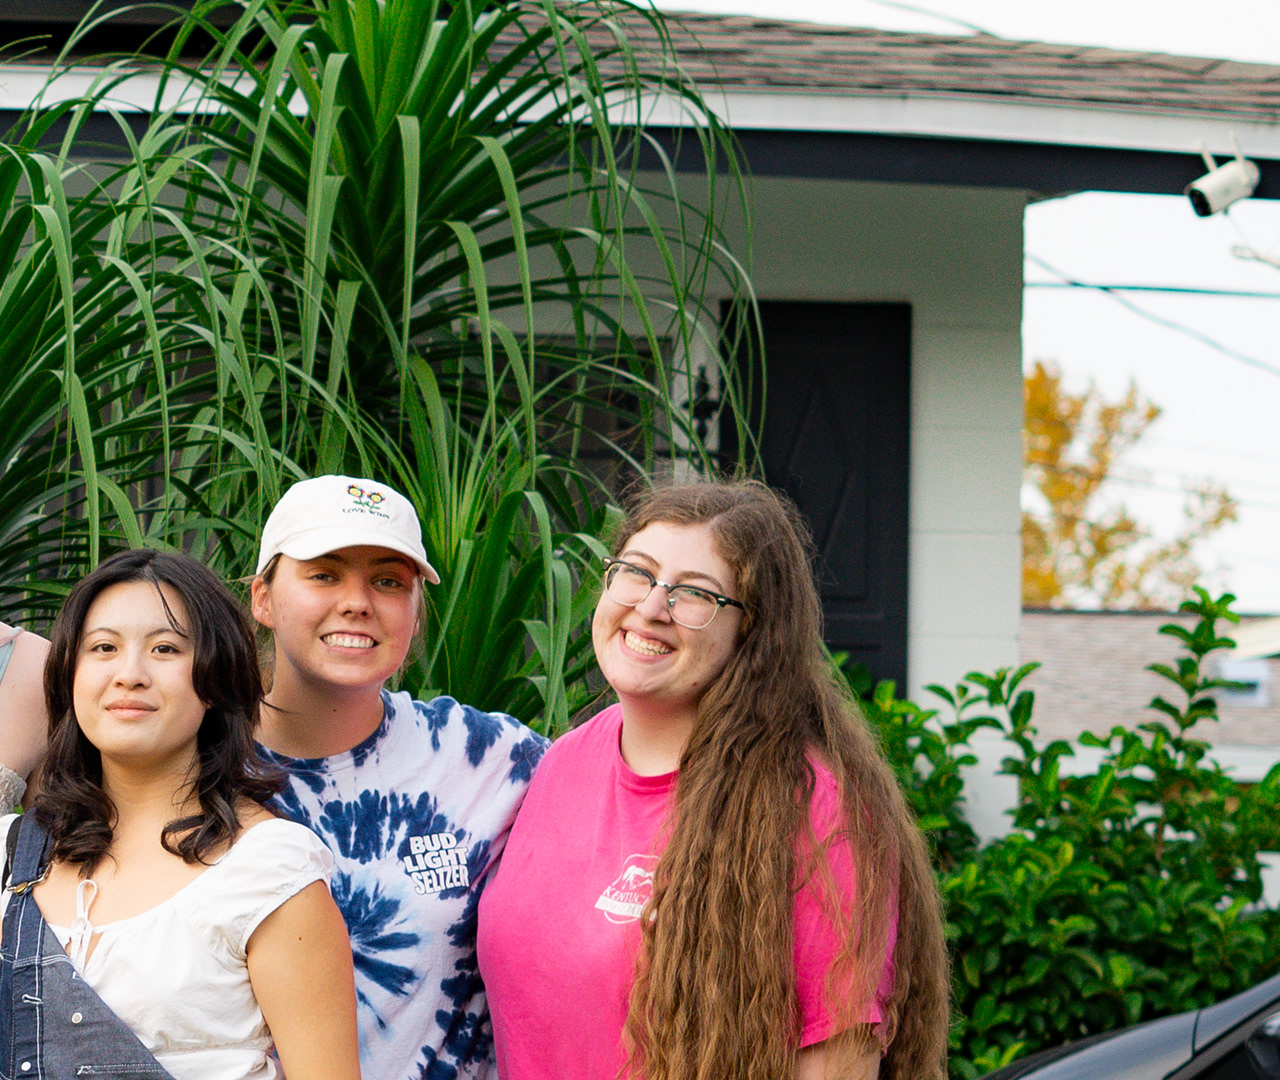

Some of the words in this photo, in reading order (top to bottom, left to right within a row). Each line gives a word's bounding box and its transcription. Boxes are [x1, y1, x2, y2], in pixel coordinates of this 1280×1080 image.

[409, 832, 457, 855] BUD
[403, 846, 468, 873] LIGHT
[411, 864, 470, 896] SELTZER
[602, 885, 650, 905] KENTUC
